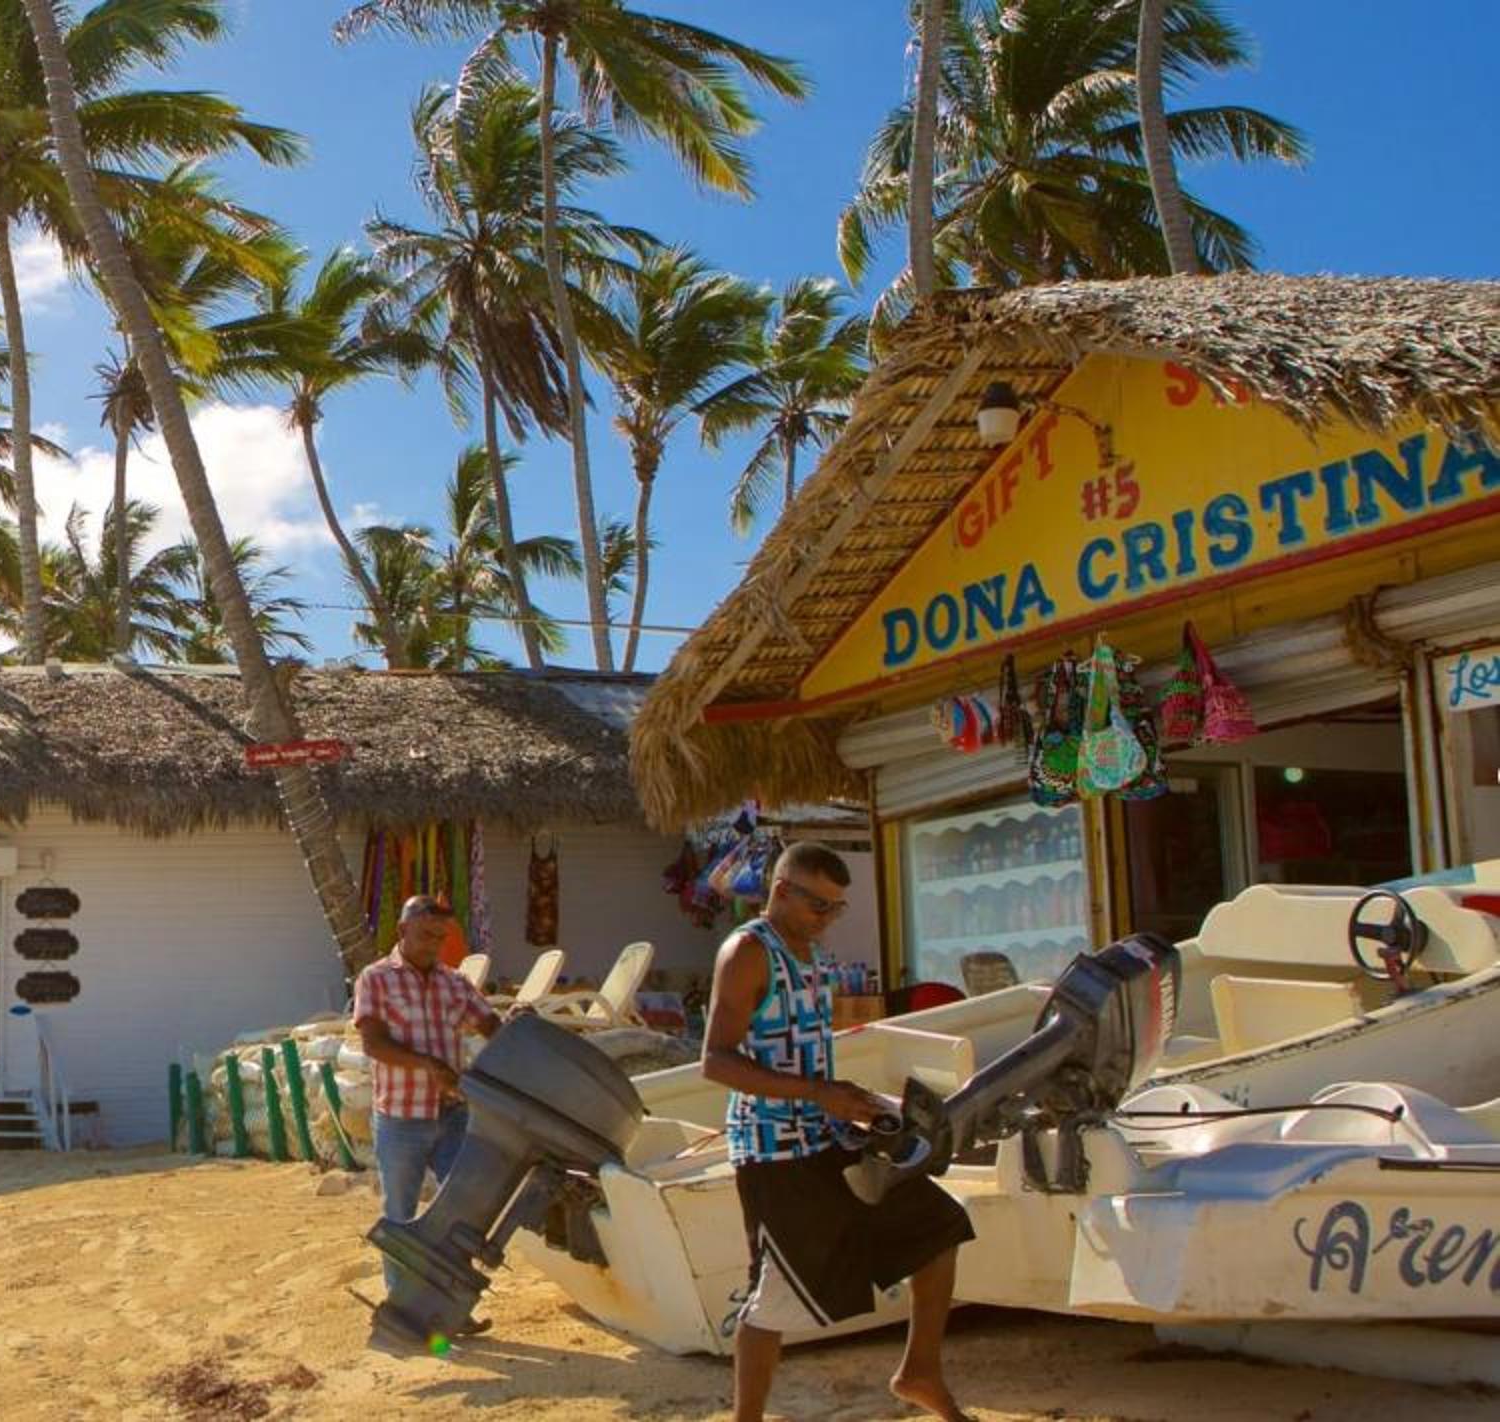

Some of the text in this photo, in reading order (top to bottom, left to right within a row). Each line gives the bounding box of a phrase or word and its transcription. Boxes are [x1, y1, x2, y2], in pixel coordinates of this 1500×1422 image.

[882, 430, 1500, 667] DONA CRISTINA
[956, 416, 1058, 549] GIFT
[1081, 458, 1141, 522] #5
